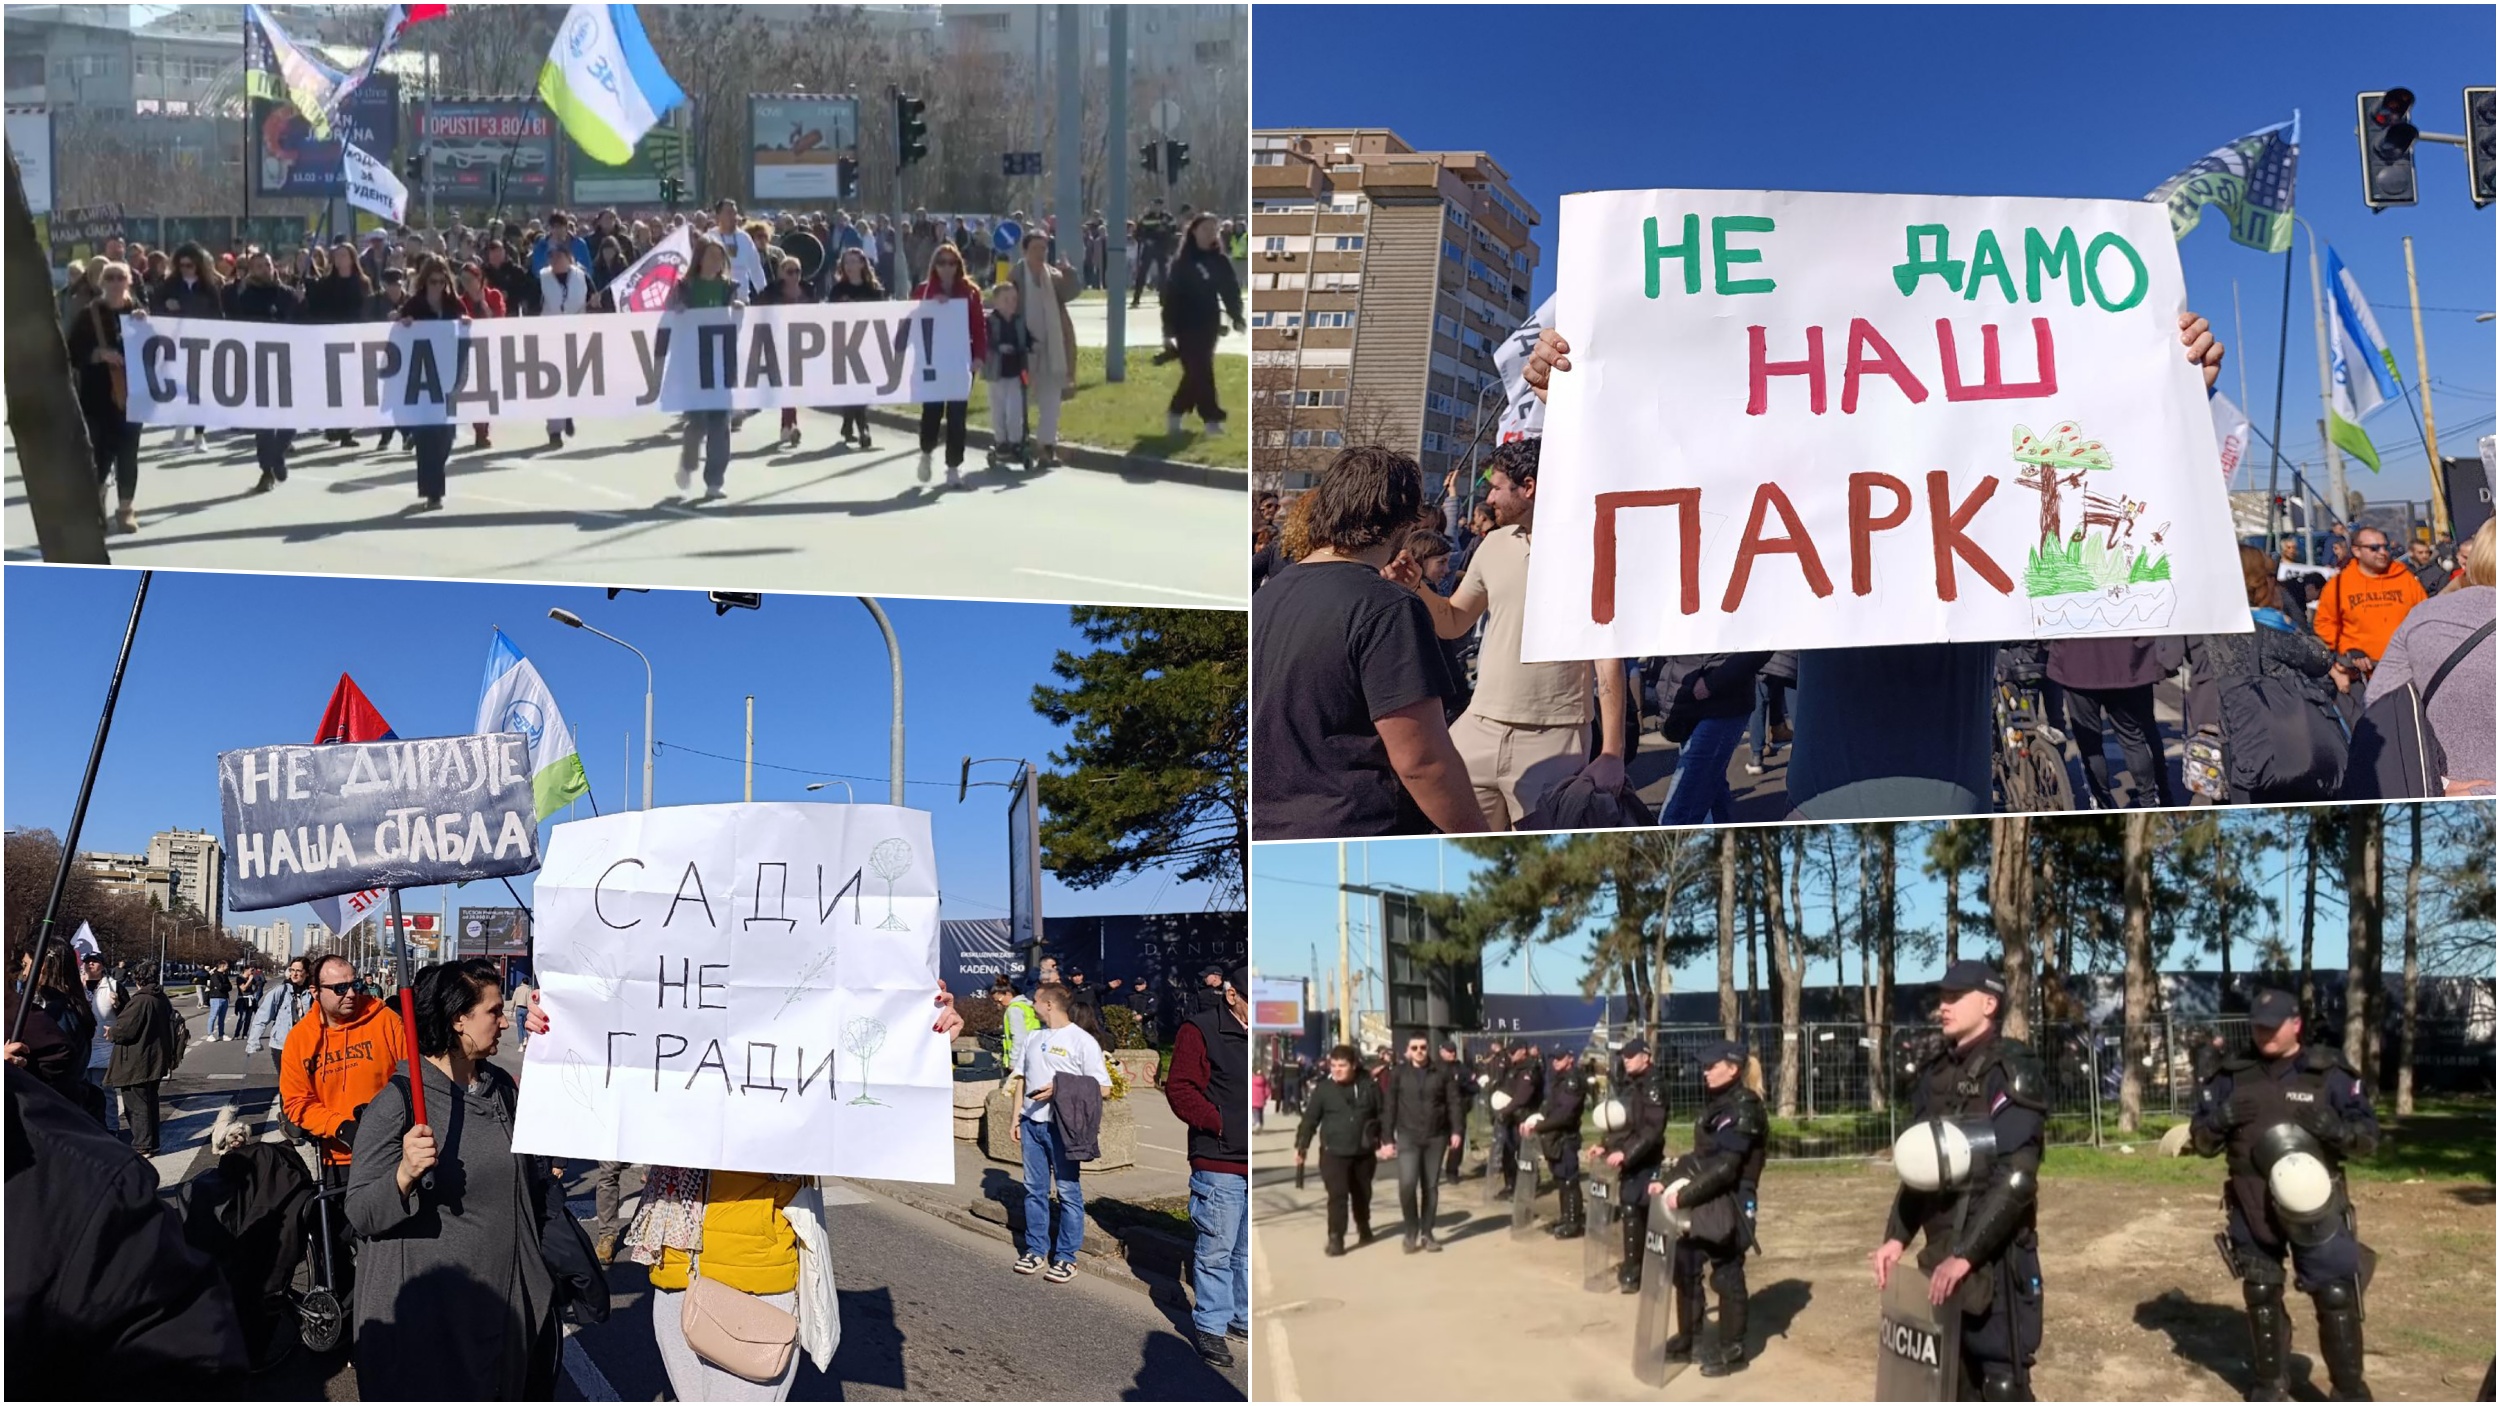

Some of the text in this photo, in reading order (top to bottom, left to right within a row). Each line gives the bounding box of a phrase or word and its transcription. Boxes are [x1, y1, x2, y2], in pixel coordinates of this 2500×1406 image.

[1643, 213, 2149, 313] НЕ ДАМО
[142, 317, 938, 417] СТОП ГРАДЊИ У ПАРКУ!
[1746, 316, 2059, 416] НАШ
[1591, 470, 2015, 626] ПАРК
[241, 749, 312, 804] НЕ
[236, 807, 532, 880] НАША СТАБЛА
[594, 858, 863, 934] САДИ
[658, 955, 730, 1010] НЕ
[960, 964, 1000, 974] KADENA
[605, 1031, 837, 1103] ГРАДИ
